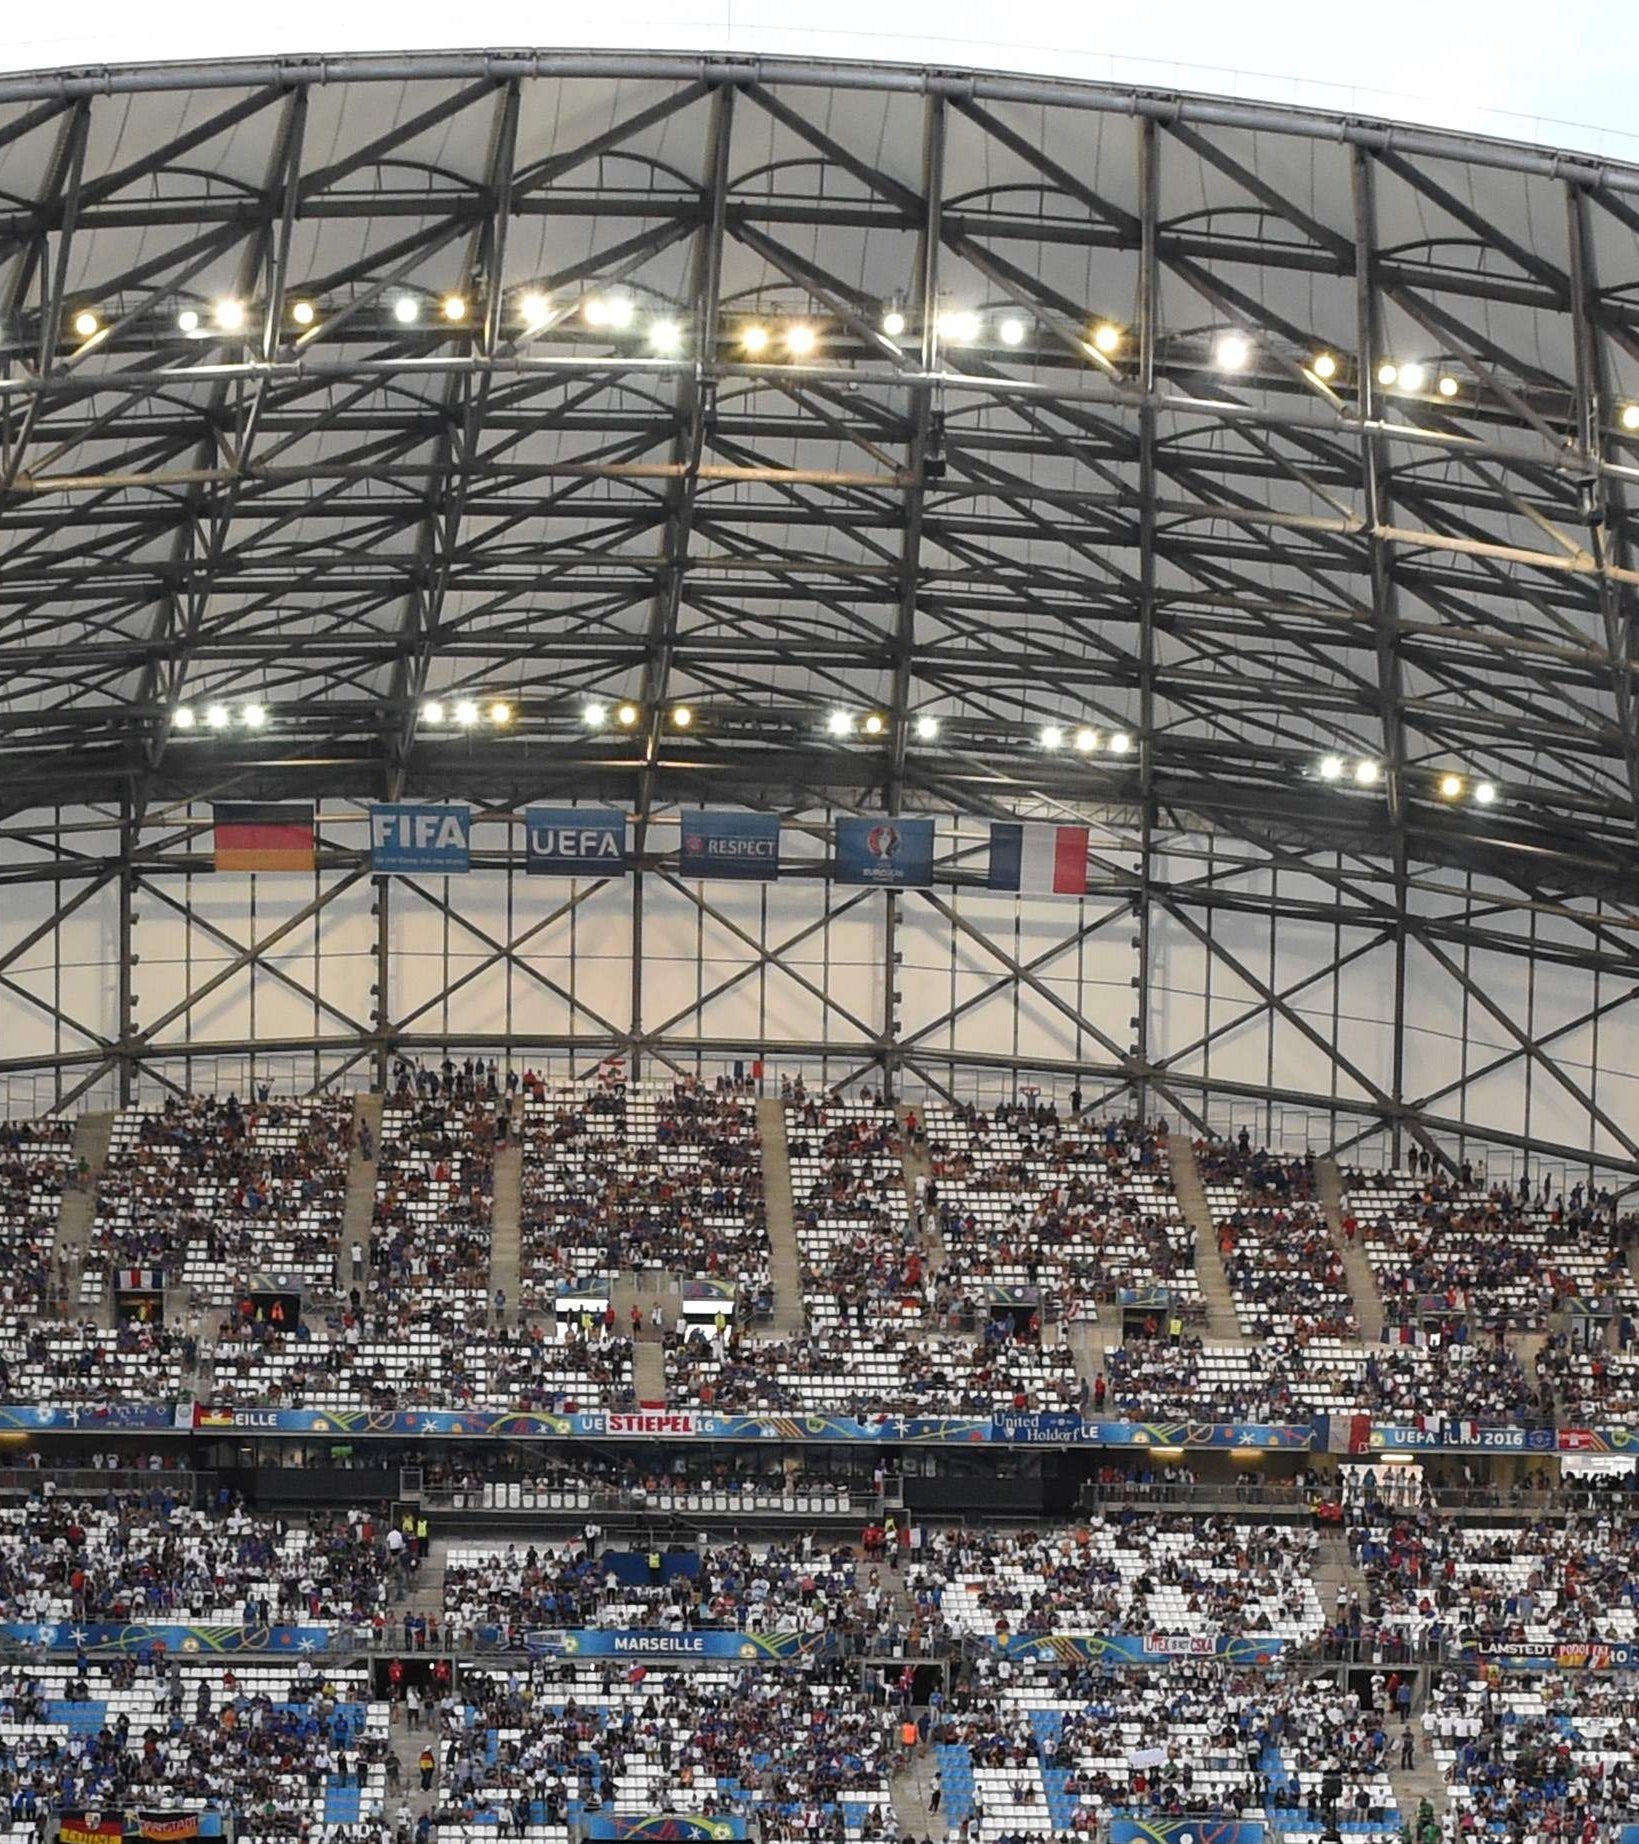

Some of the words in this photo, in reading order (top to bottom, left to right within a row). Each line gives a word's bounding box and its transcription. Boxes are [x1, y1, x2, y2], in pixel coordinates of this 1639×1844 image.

[373, 814, 467, 849] FIFA
[531, 830, 620, 857] UEFA
[708, 841, 775, 856] RESPECT
[609, 1415, 693, 1433] STIEPEL
[993, 1412, 1041, 1428] United
[1395, 1431, 1436, 1445] UEFA
[1484, 1432, 1524, 1446] 2016
[614, 1637, 704, 1652] MARSEILLE
[1190, 1638, 1213, 1653] CSKA
[1478, 1643, 1554, 1656] LAMSTEDT
